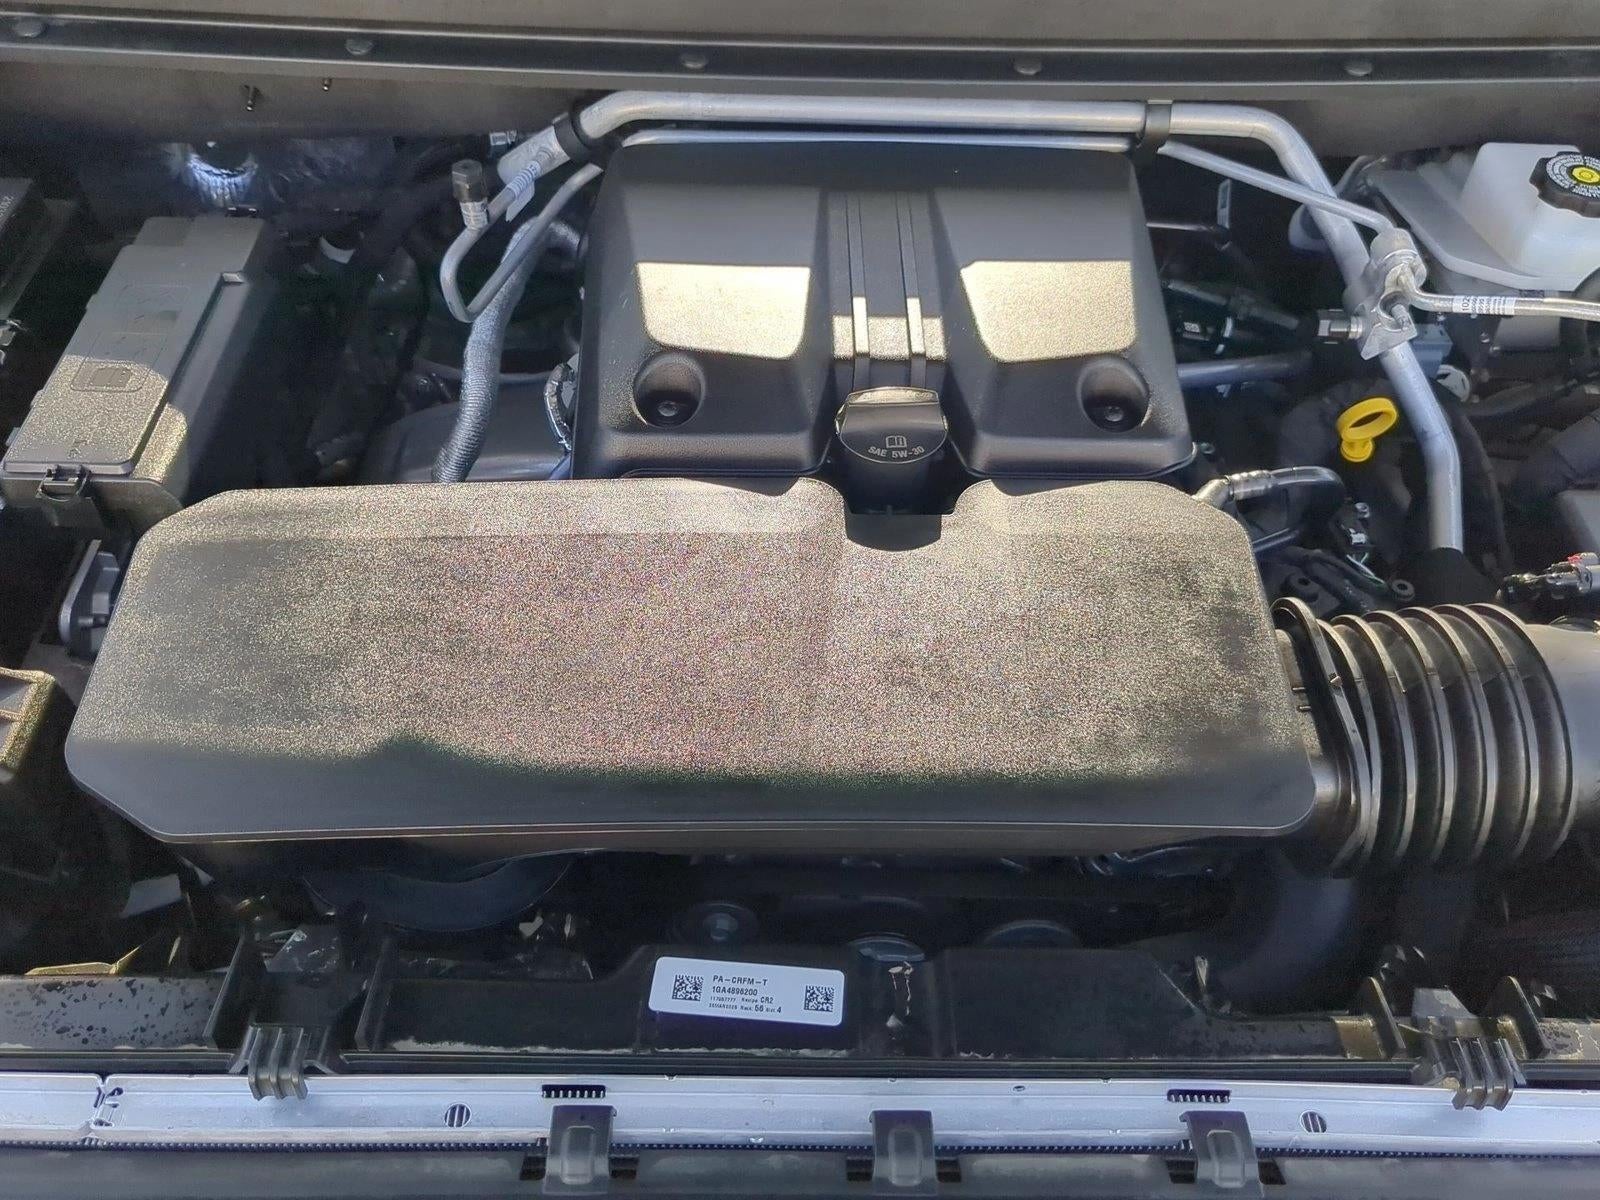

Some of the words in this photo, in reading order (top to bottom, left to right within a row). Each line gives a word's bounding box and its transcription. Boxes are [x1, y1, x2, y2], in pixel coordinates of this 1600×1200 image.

[868, 446, 887, 456] SAE
[891, 446, 925, 458] 5W-30
[713, 975, 768, 986] PA-CRFM-T
